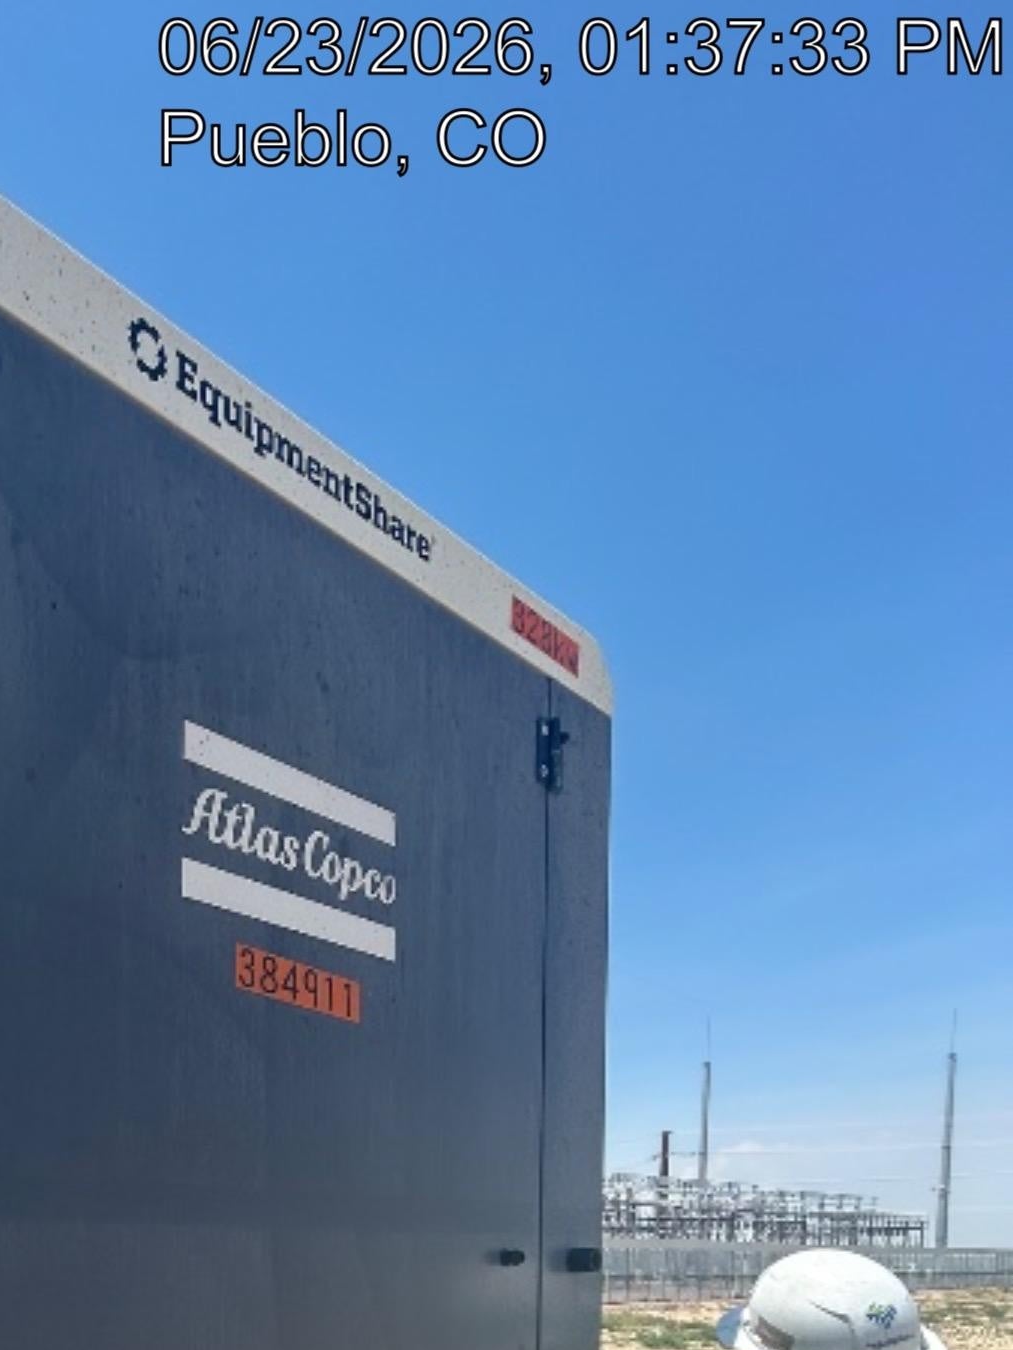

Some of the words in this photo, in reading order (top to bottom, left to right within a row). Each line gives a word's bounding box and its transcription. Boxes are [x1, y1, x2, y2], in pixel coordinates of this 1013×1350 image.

[175, 350, 430, 562] EquipmentShare
[181, 787, 300, 872] Atlas
[303, 830, 397, 905] Copco
[238, 947, 352, 1018] 384911
